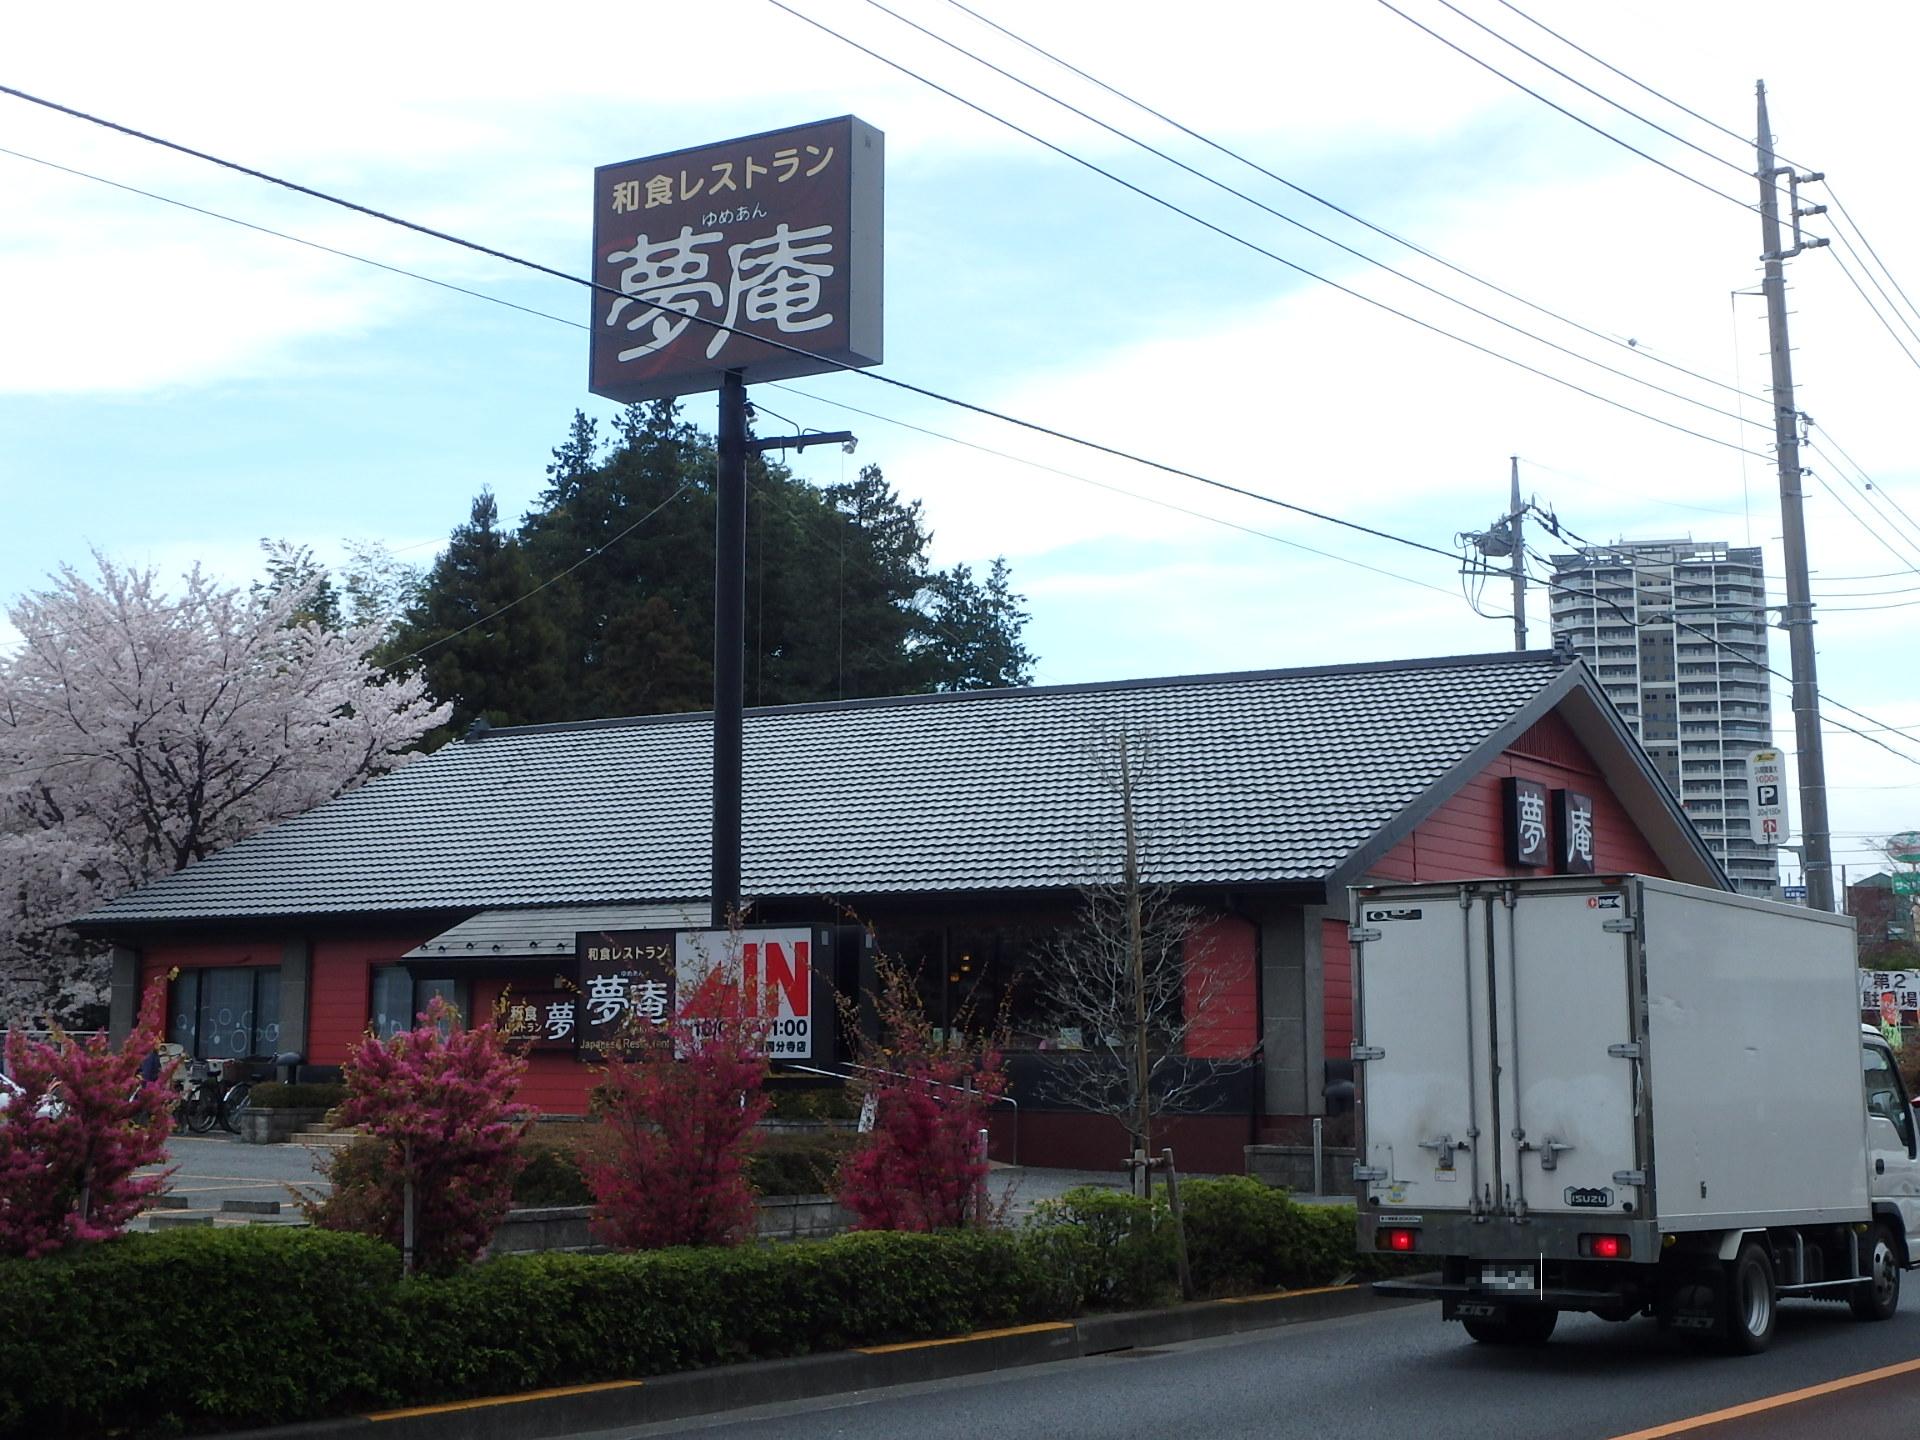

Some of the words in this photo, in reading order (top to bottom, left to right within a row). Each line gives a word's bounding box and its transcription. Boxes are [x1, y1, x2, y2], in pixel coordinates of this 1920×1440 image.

[612, 146, 834, 214] 和食レストラン
[701, 202, 768, 228] ゆめあん
[606, 224, 835, 363] 夢庵
[1760, 787, 1775, 804] P
[1518, 790, 1593, 863] 夢庵
[587, 945, 667, 961] 和食レストラン
[743, 942, 809, 1017] IN
[1873, 973, 1906, 989] 第2
[586, 973, 668, 1029] 夢庵
[1862, 991, 1918, 1008] 駐場
[544, 1002, 576, 1043] 夢
[1571, 1193, 1606, 1204] ISUZU
